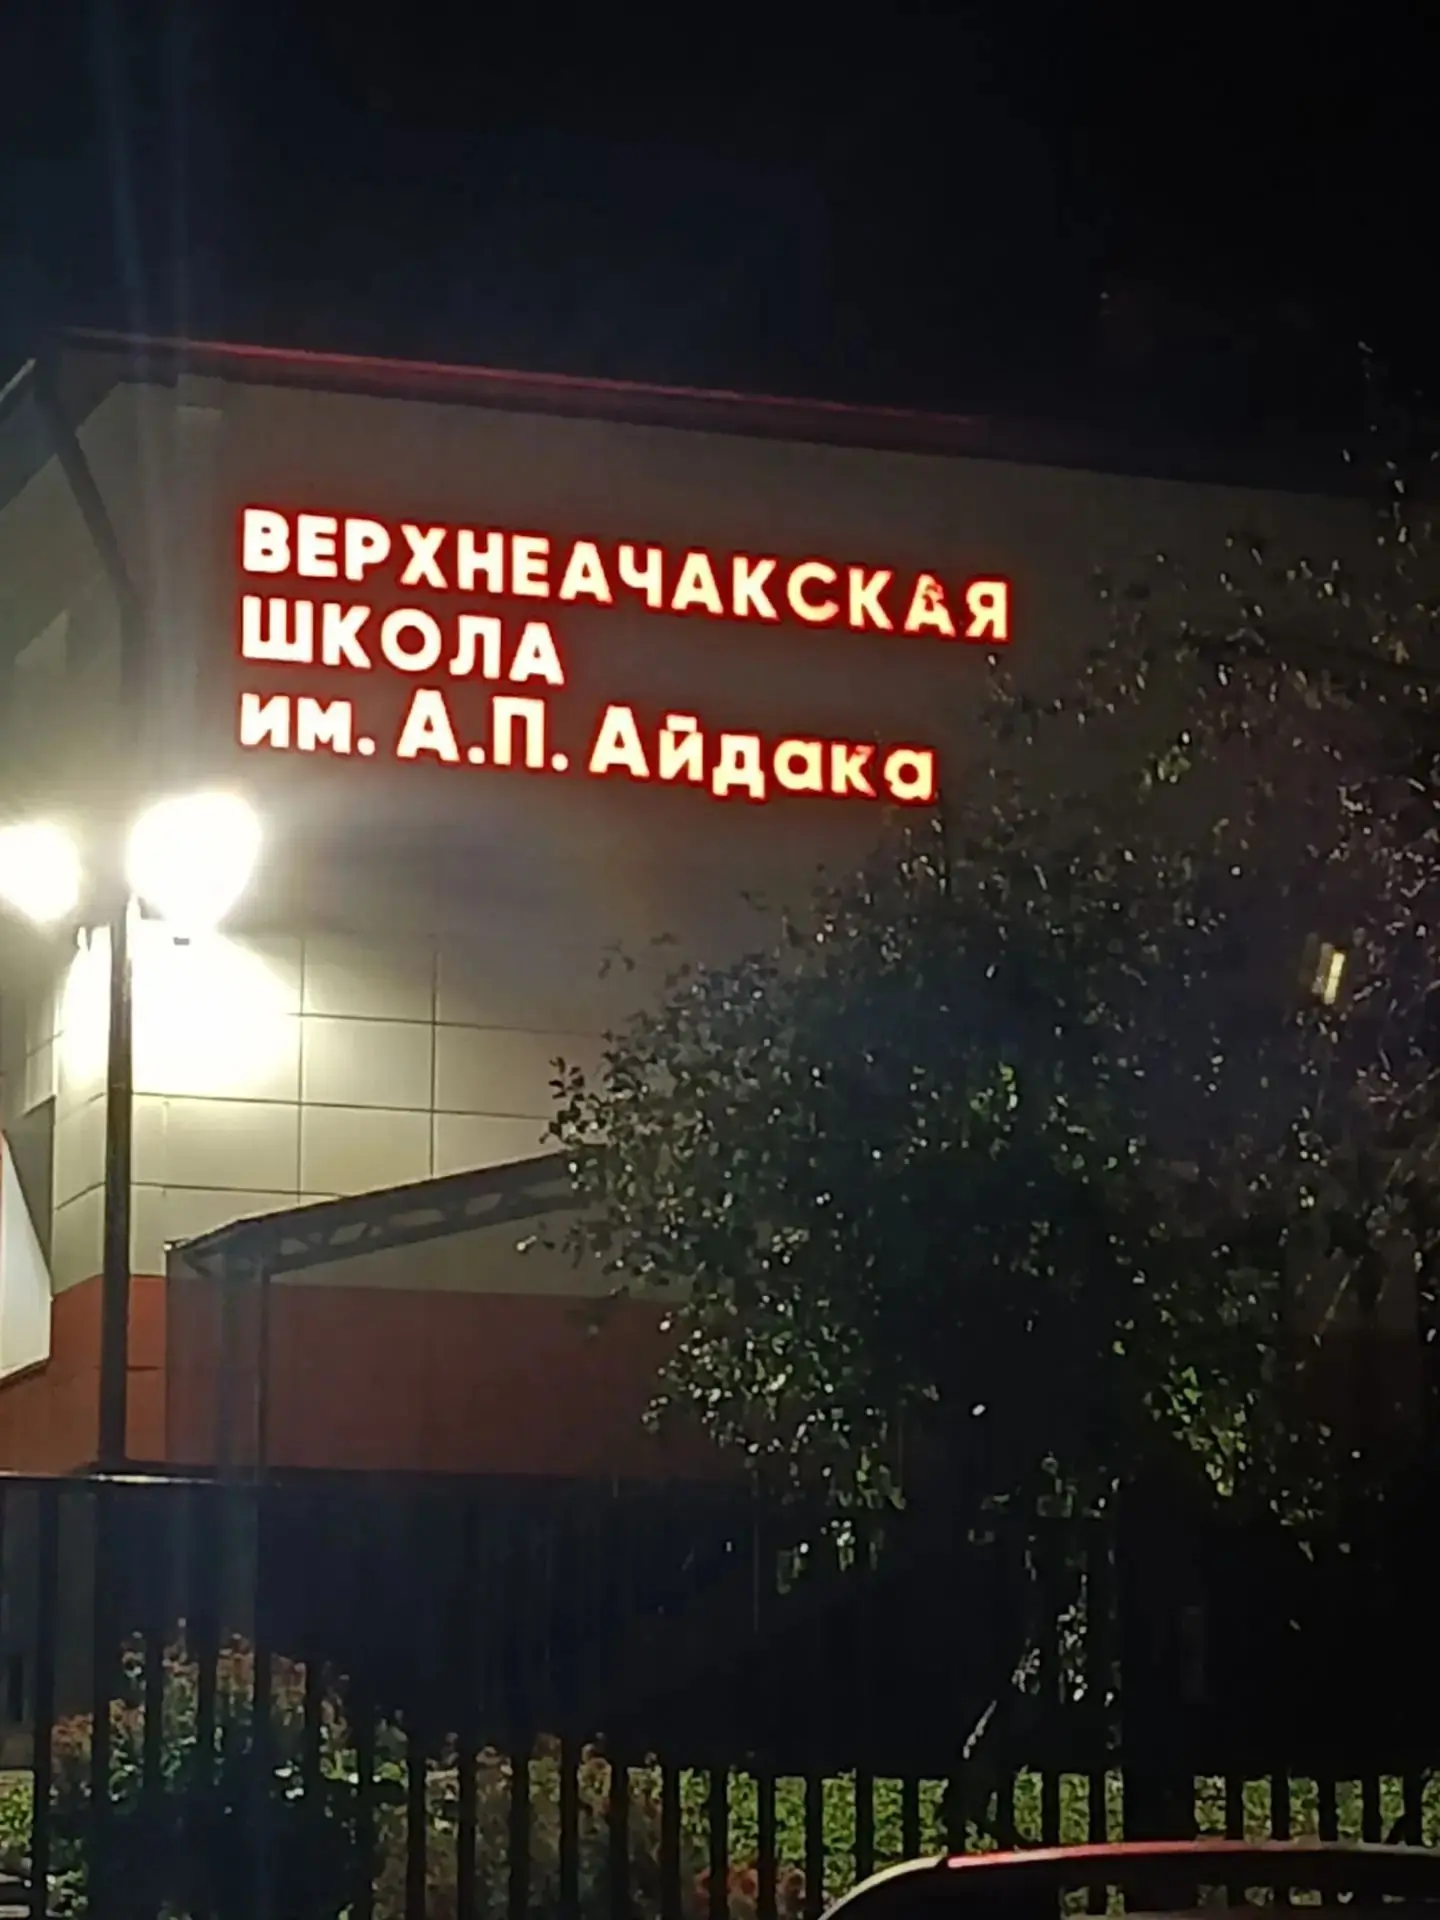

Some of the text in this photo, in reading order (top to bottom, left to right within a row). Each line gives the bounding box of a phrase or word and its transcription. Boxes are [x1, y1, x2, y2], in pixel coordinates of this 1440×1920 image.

[242, 508, 1008, 640] ВЕРХНЕАЧАКСКАЯ
[241, 594, 565, 687] ШКОЛА
[239, 688, 935, 801] им. А.П. Айдака
